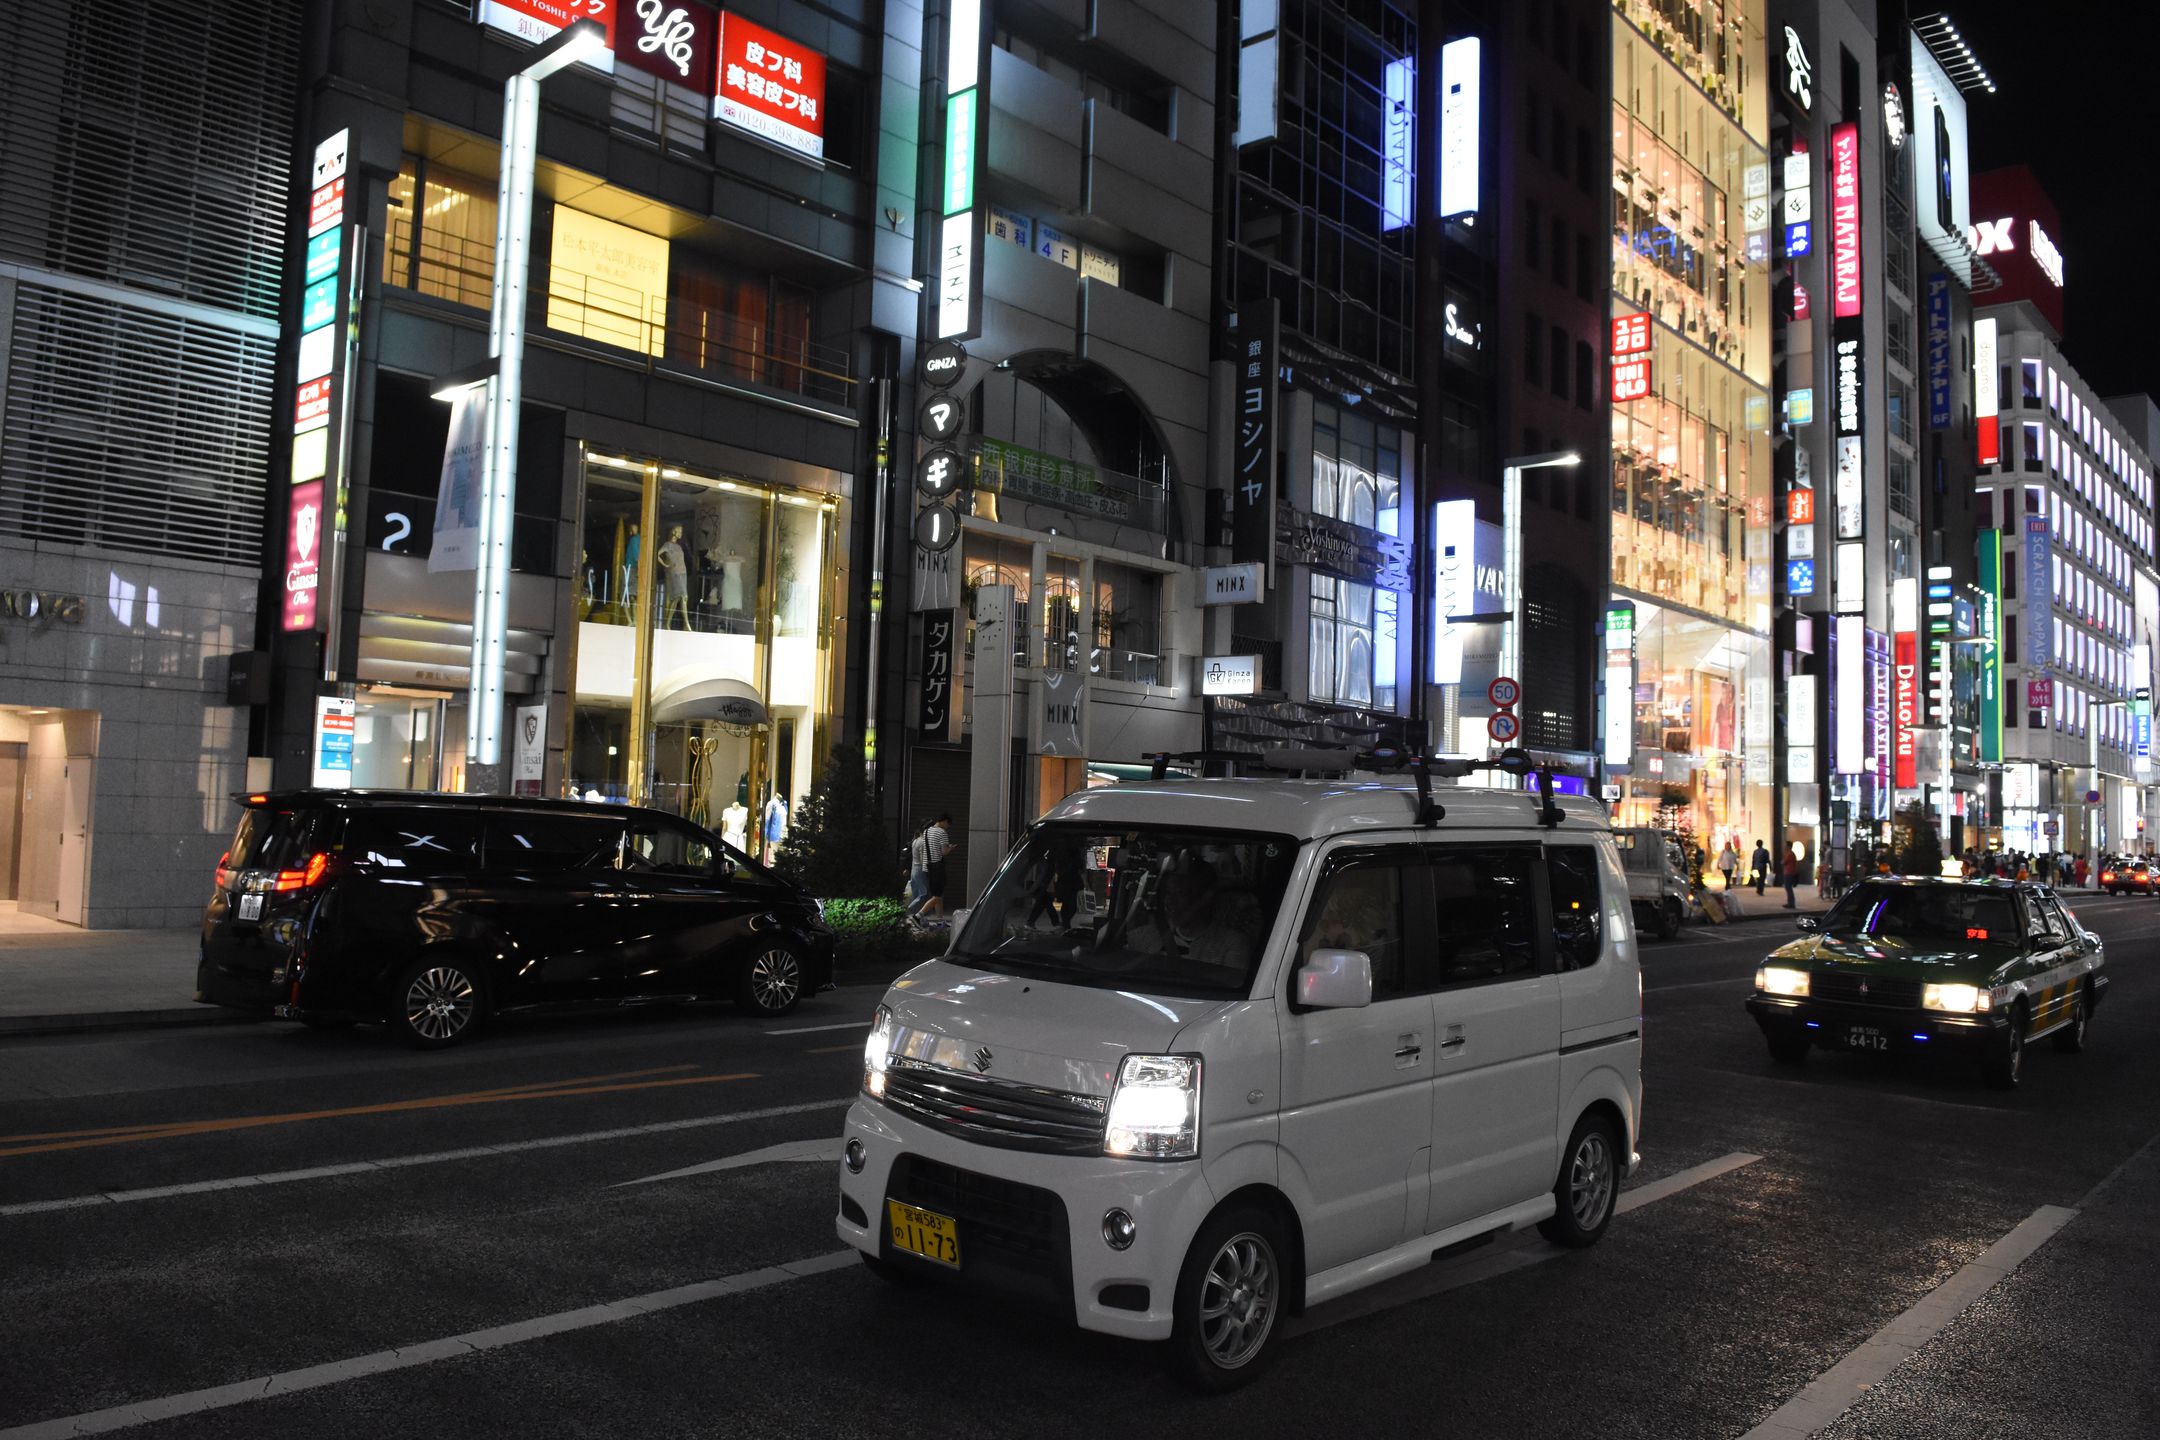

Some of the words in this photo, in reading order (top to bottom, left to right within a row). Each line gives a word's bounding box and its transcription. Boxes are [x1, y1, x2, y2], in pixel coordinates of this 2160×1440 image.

[745, 41, 802, 84] 皮フ科
[726, 63, 817, 121] 美容皮フ科
[738, 108, 820, 153] 0120-398-885
[1836, 203, 1857, 303] NATARAJ
[945, 244, 965, 308] MINX
[927, 358, 957, 372] GINZA
[1615, 363, 1643, 380] UNI
[1979, 341, 1990, 395] docomo
[1615, 379, 1646, 399] QLO
[917, 553, 949, 574] MINX
[1216, 575, 1246, 593] MINX
[924, 621, 950, 731] タカゲン
[1227, 669, 1251, 677] Ginza
[1495, 685, 1513, 700] 50
[1047, 703, 1078, 725] MINX
[1849, 1033, 1888, 1051] 64-12
[906, 1226, 957, 1263] 11-73
